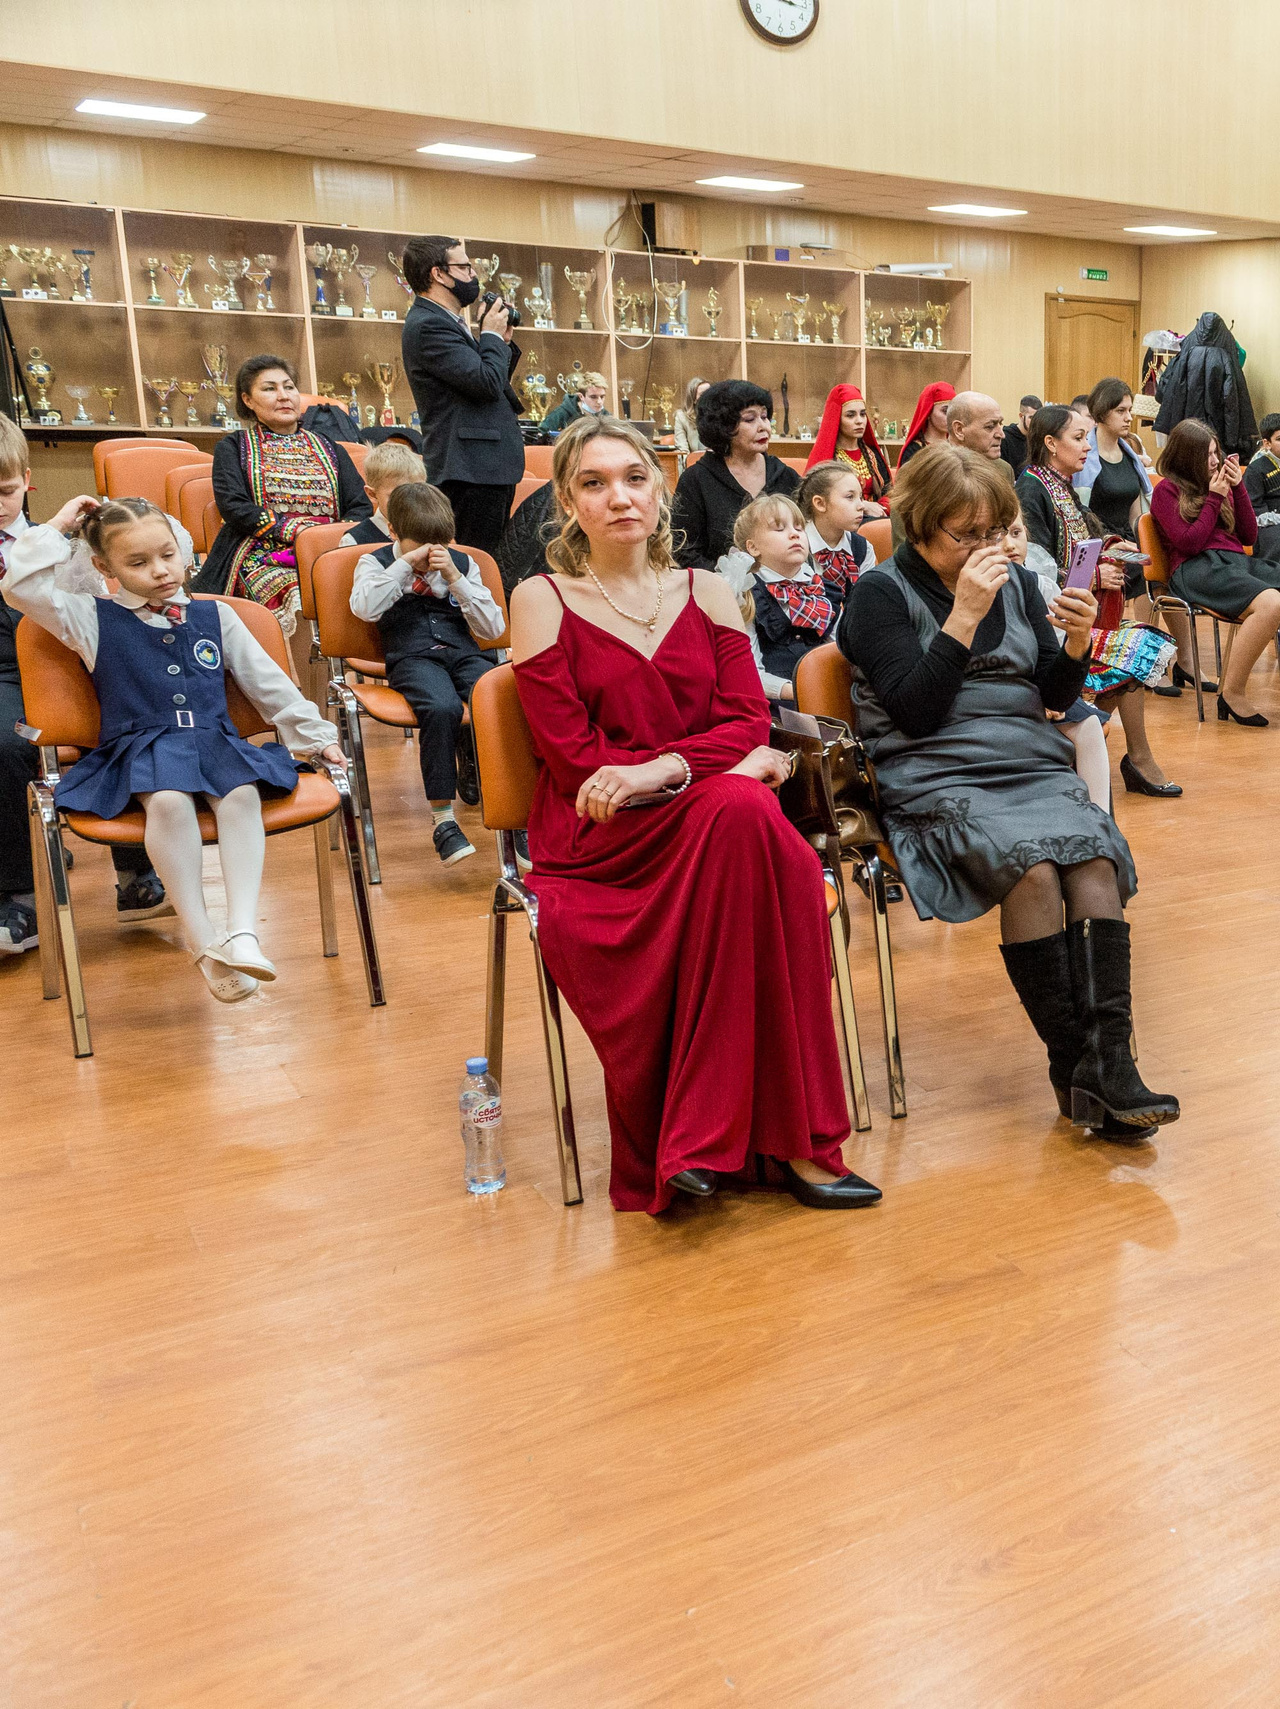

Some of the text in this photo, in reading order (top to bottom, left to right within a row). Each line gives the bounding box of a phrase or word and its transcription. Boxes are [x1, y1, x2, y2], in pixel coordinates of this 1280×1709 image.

[755, 3, 762, 13] 8
[766, 16, 771, 26] 7
[798, 12, 804, 21] 4
[777, 22, 783, 32] 6
[789, 20, 795, 30] 5
